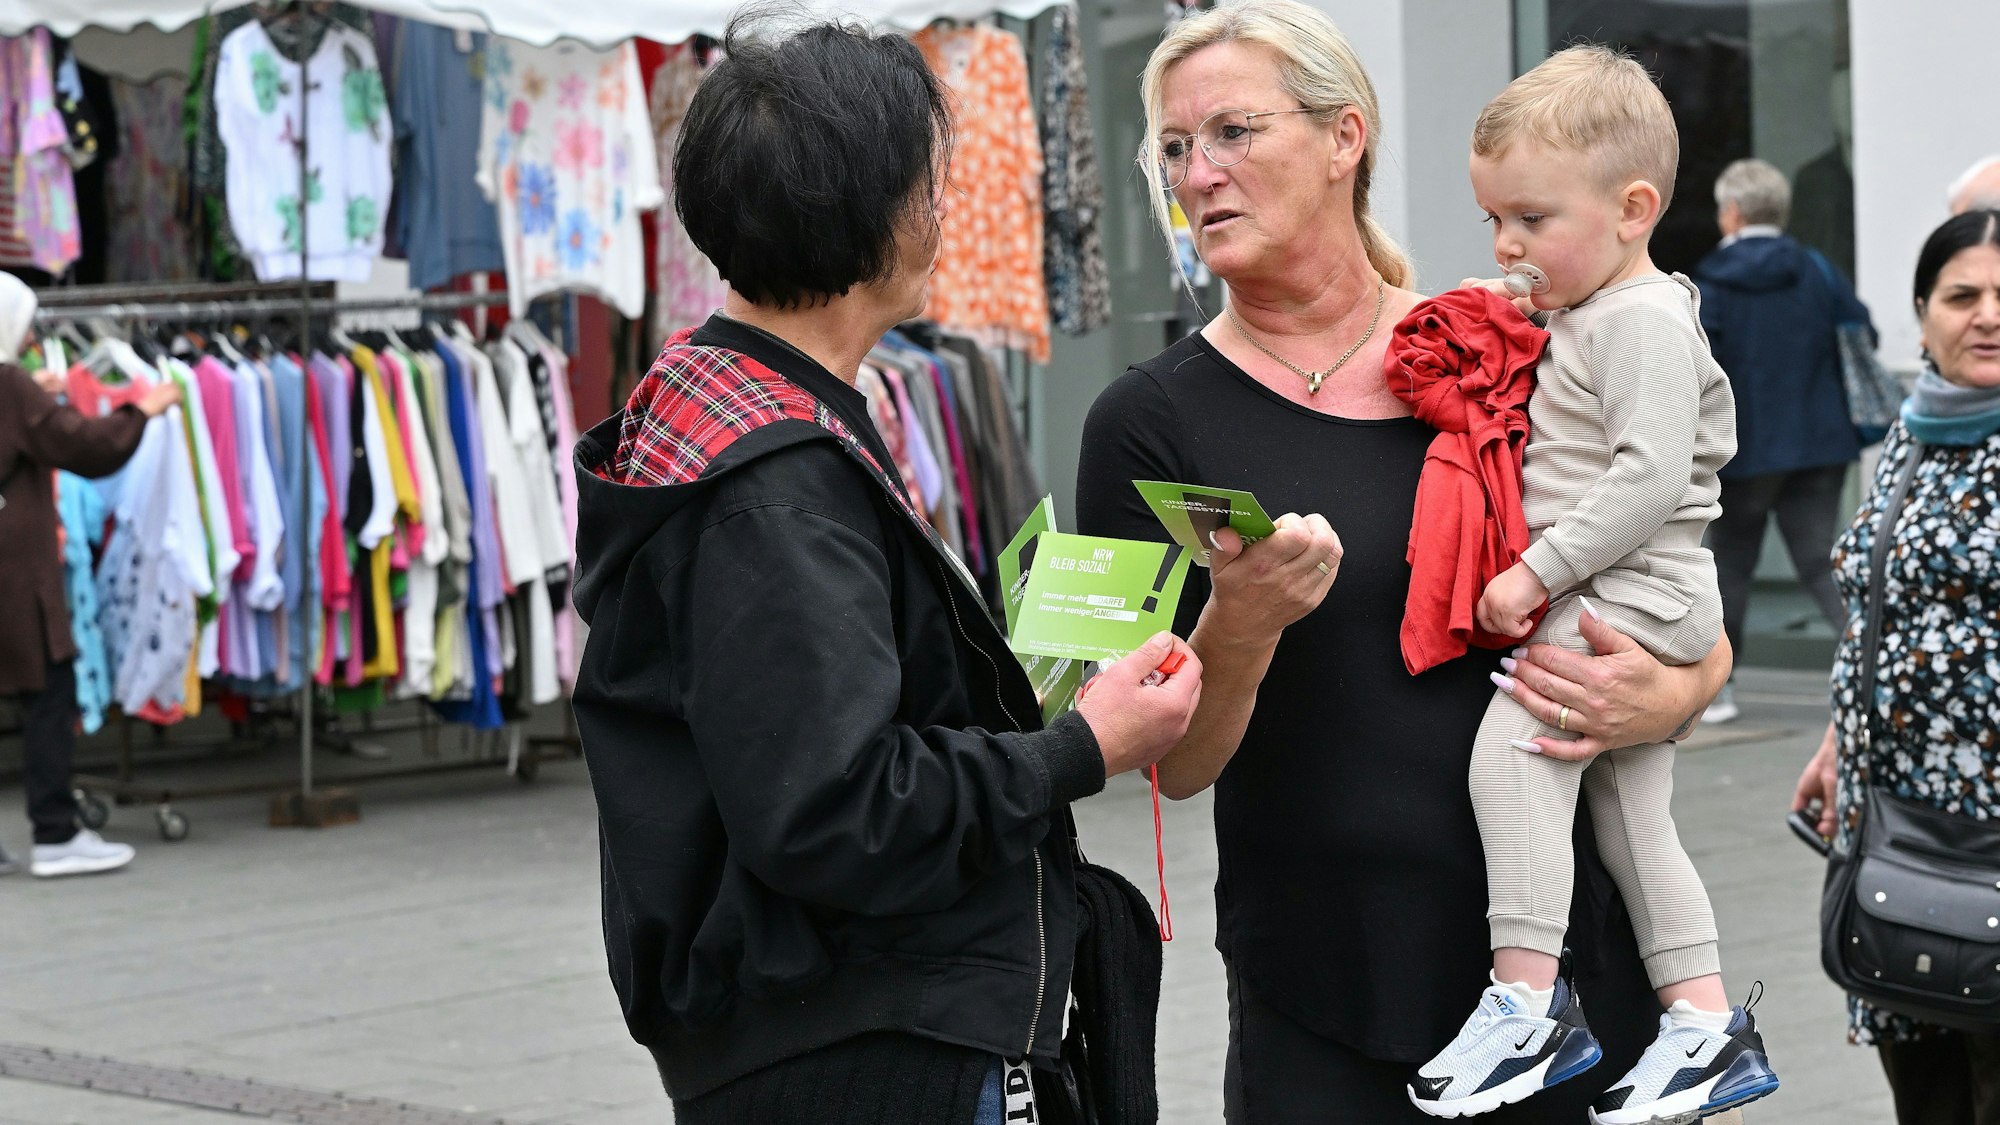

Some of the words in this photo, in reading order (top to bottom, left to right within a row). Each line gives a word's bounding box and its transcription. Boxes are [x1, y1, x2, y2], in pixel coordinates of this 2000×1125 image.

[1161, 499, 1207, 508] KINDER-
[1164, 504, 1251, 516] TAGESSTÄTTEN
[1092, 547, 1115, 562] NRW
[1050, 556, 1076, 571] BLEIB
[1077, 559, 1112, 575] SOZIAL!
[1067, 593, 1088, 603] mehr
[1038, 602, 1063, 613] Immer
[1064, 605, 1093, 617] weniger
